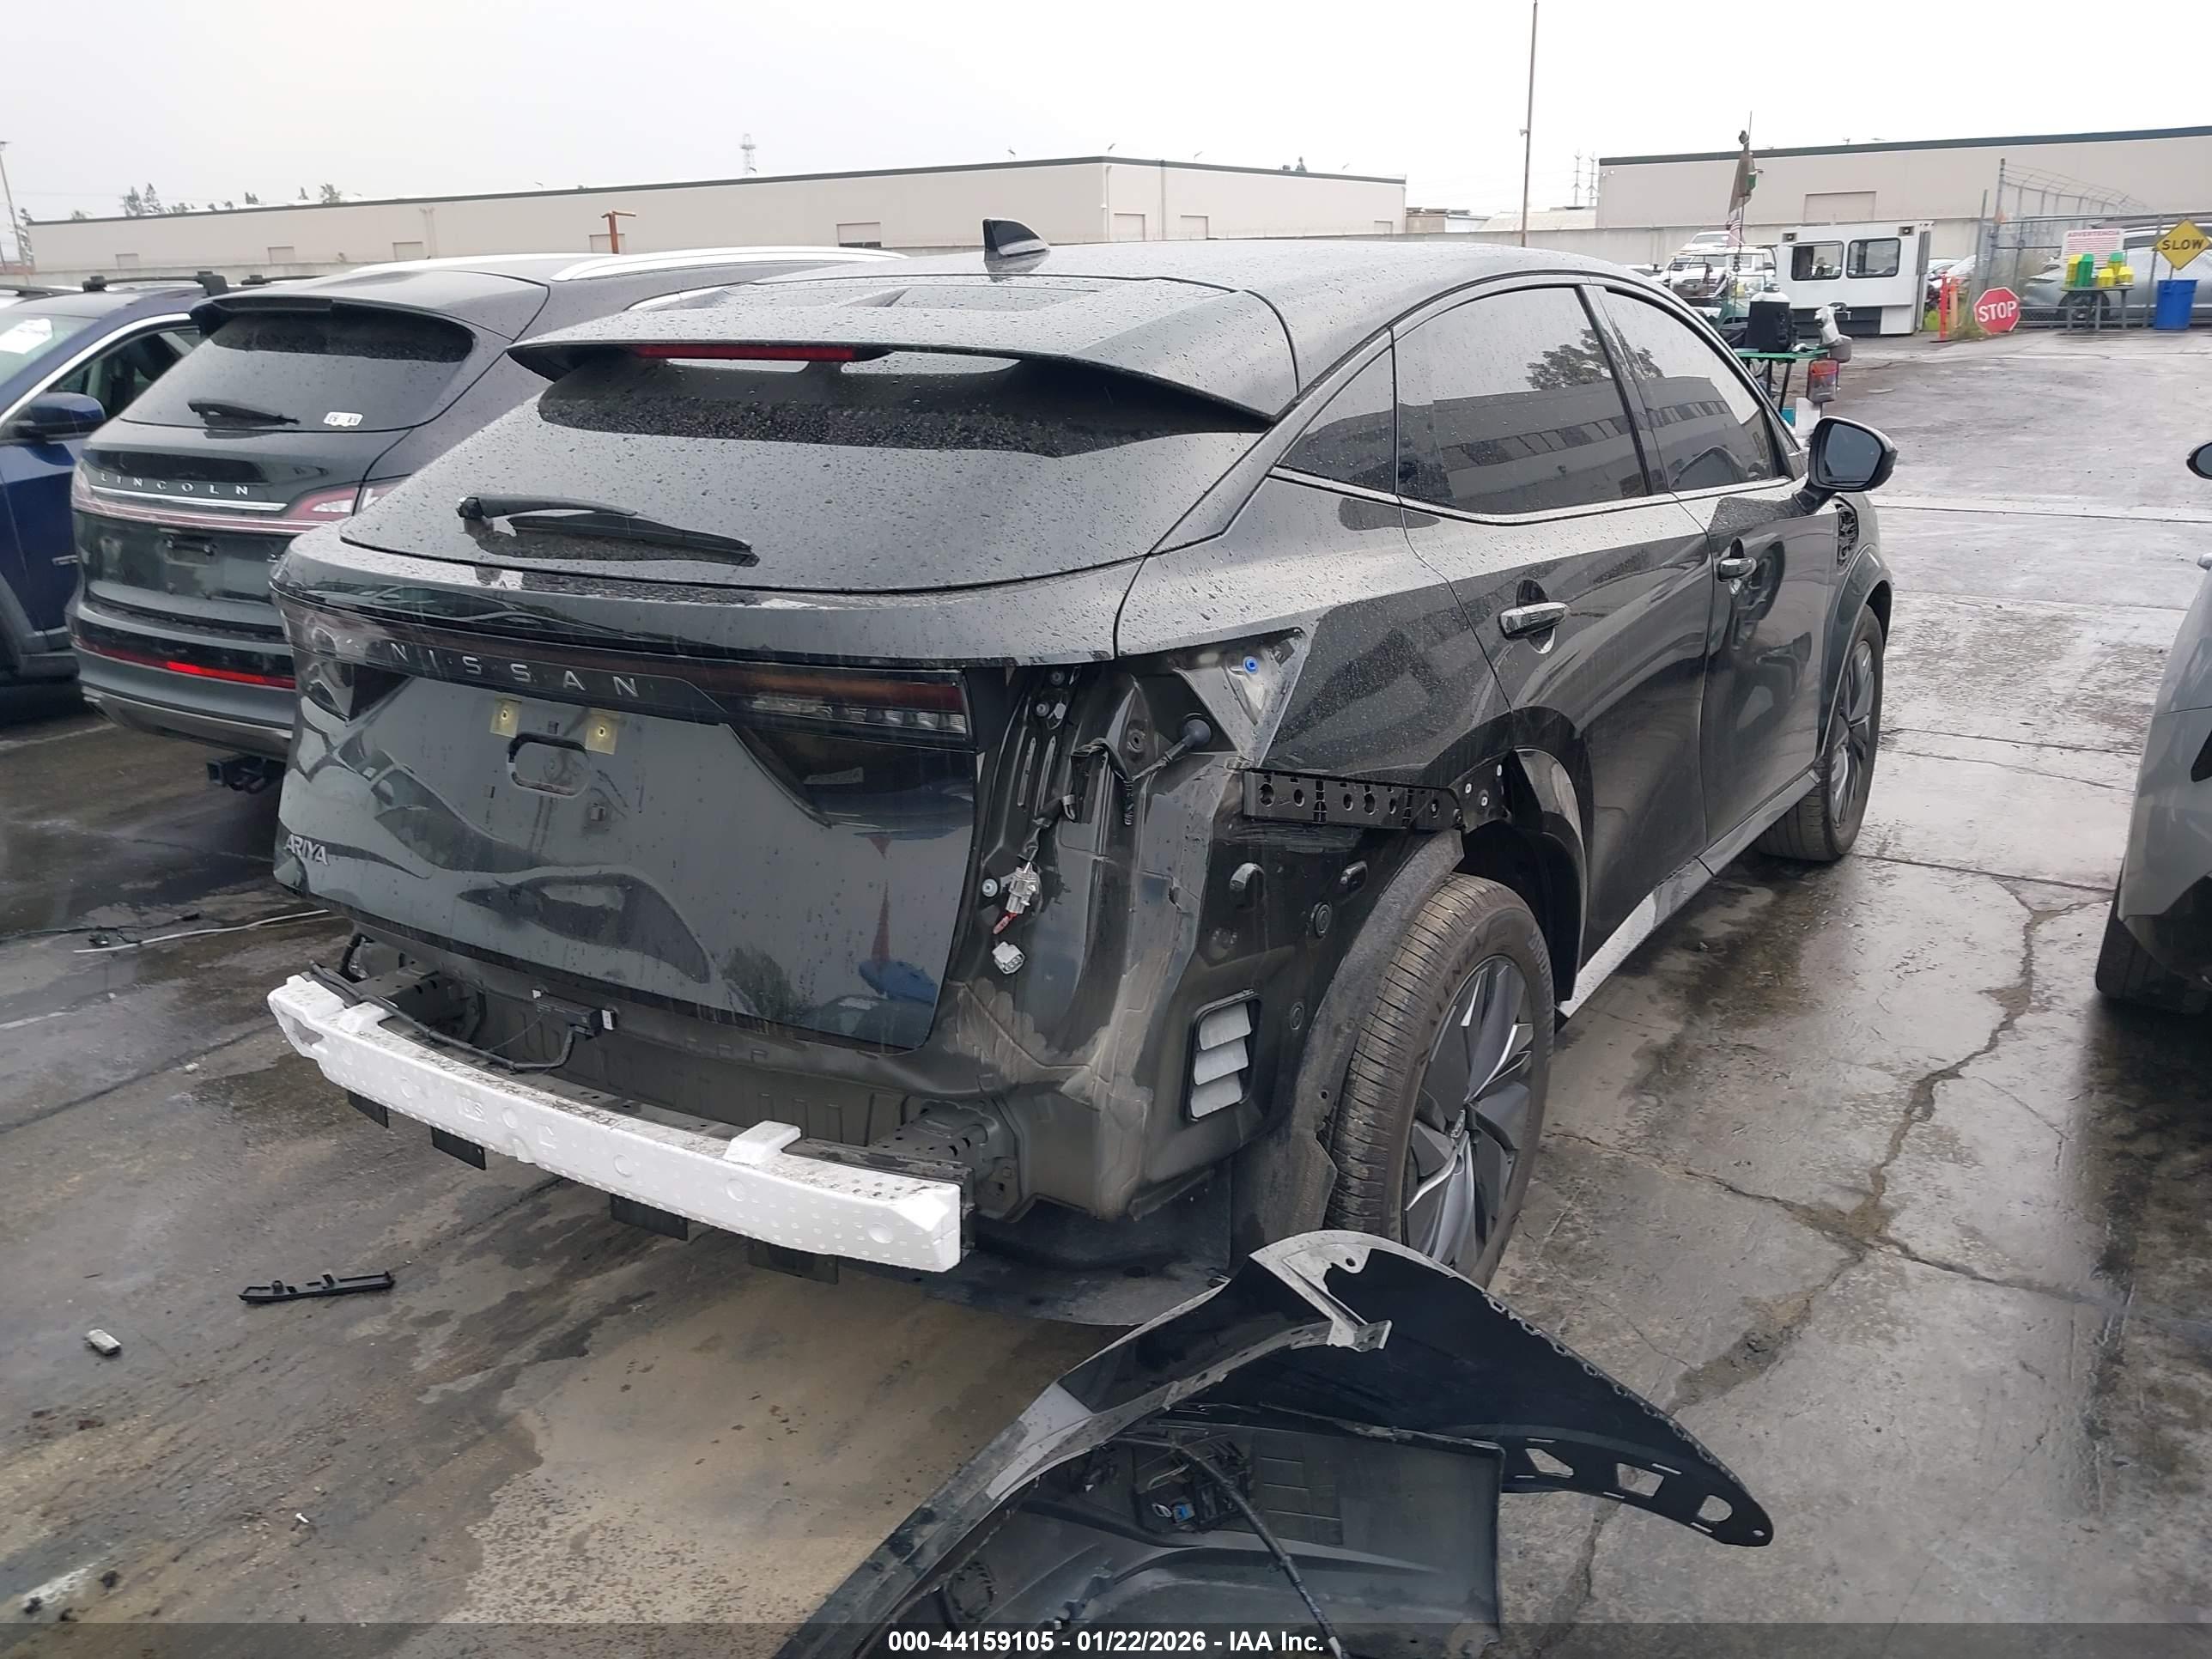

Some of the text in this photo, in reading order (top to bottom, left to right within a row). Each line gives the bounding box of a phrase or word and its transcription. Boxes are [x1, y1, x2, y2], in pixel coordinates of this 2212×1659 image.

[2161, 239, 2204, 251] SLOW
[1978, 301, 2017, 323] STOP
[100, 472, 249, 496] LINCOLN
[390, 642, 640, 698] NISSAN
[283, 834, 329, 866] ARIYA
